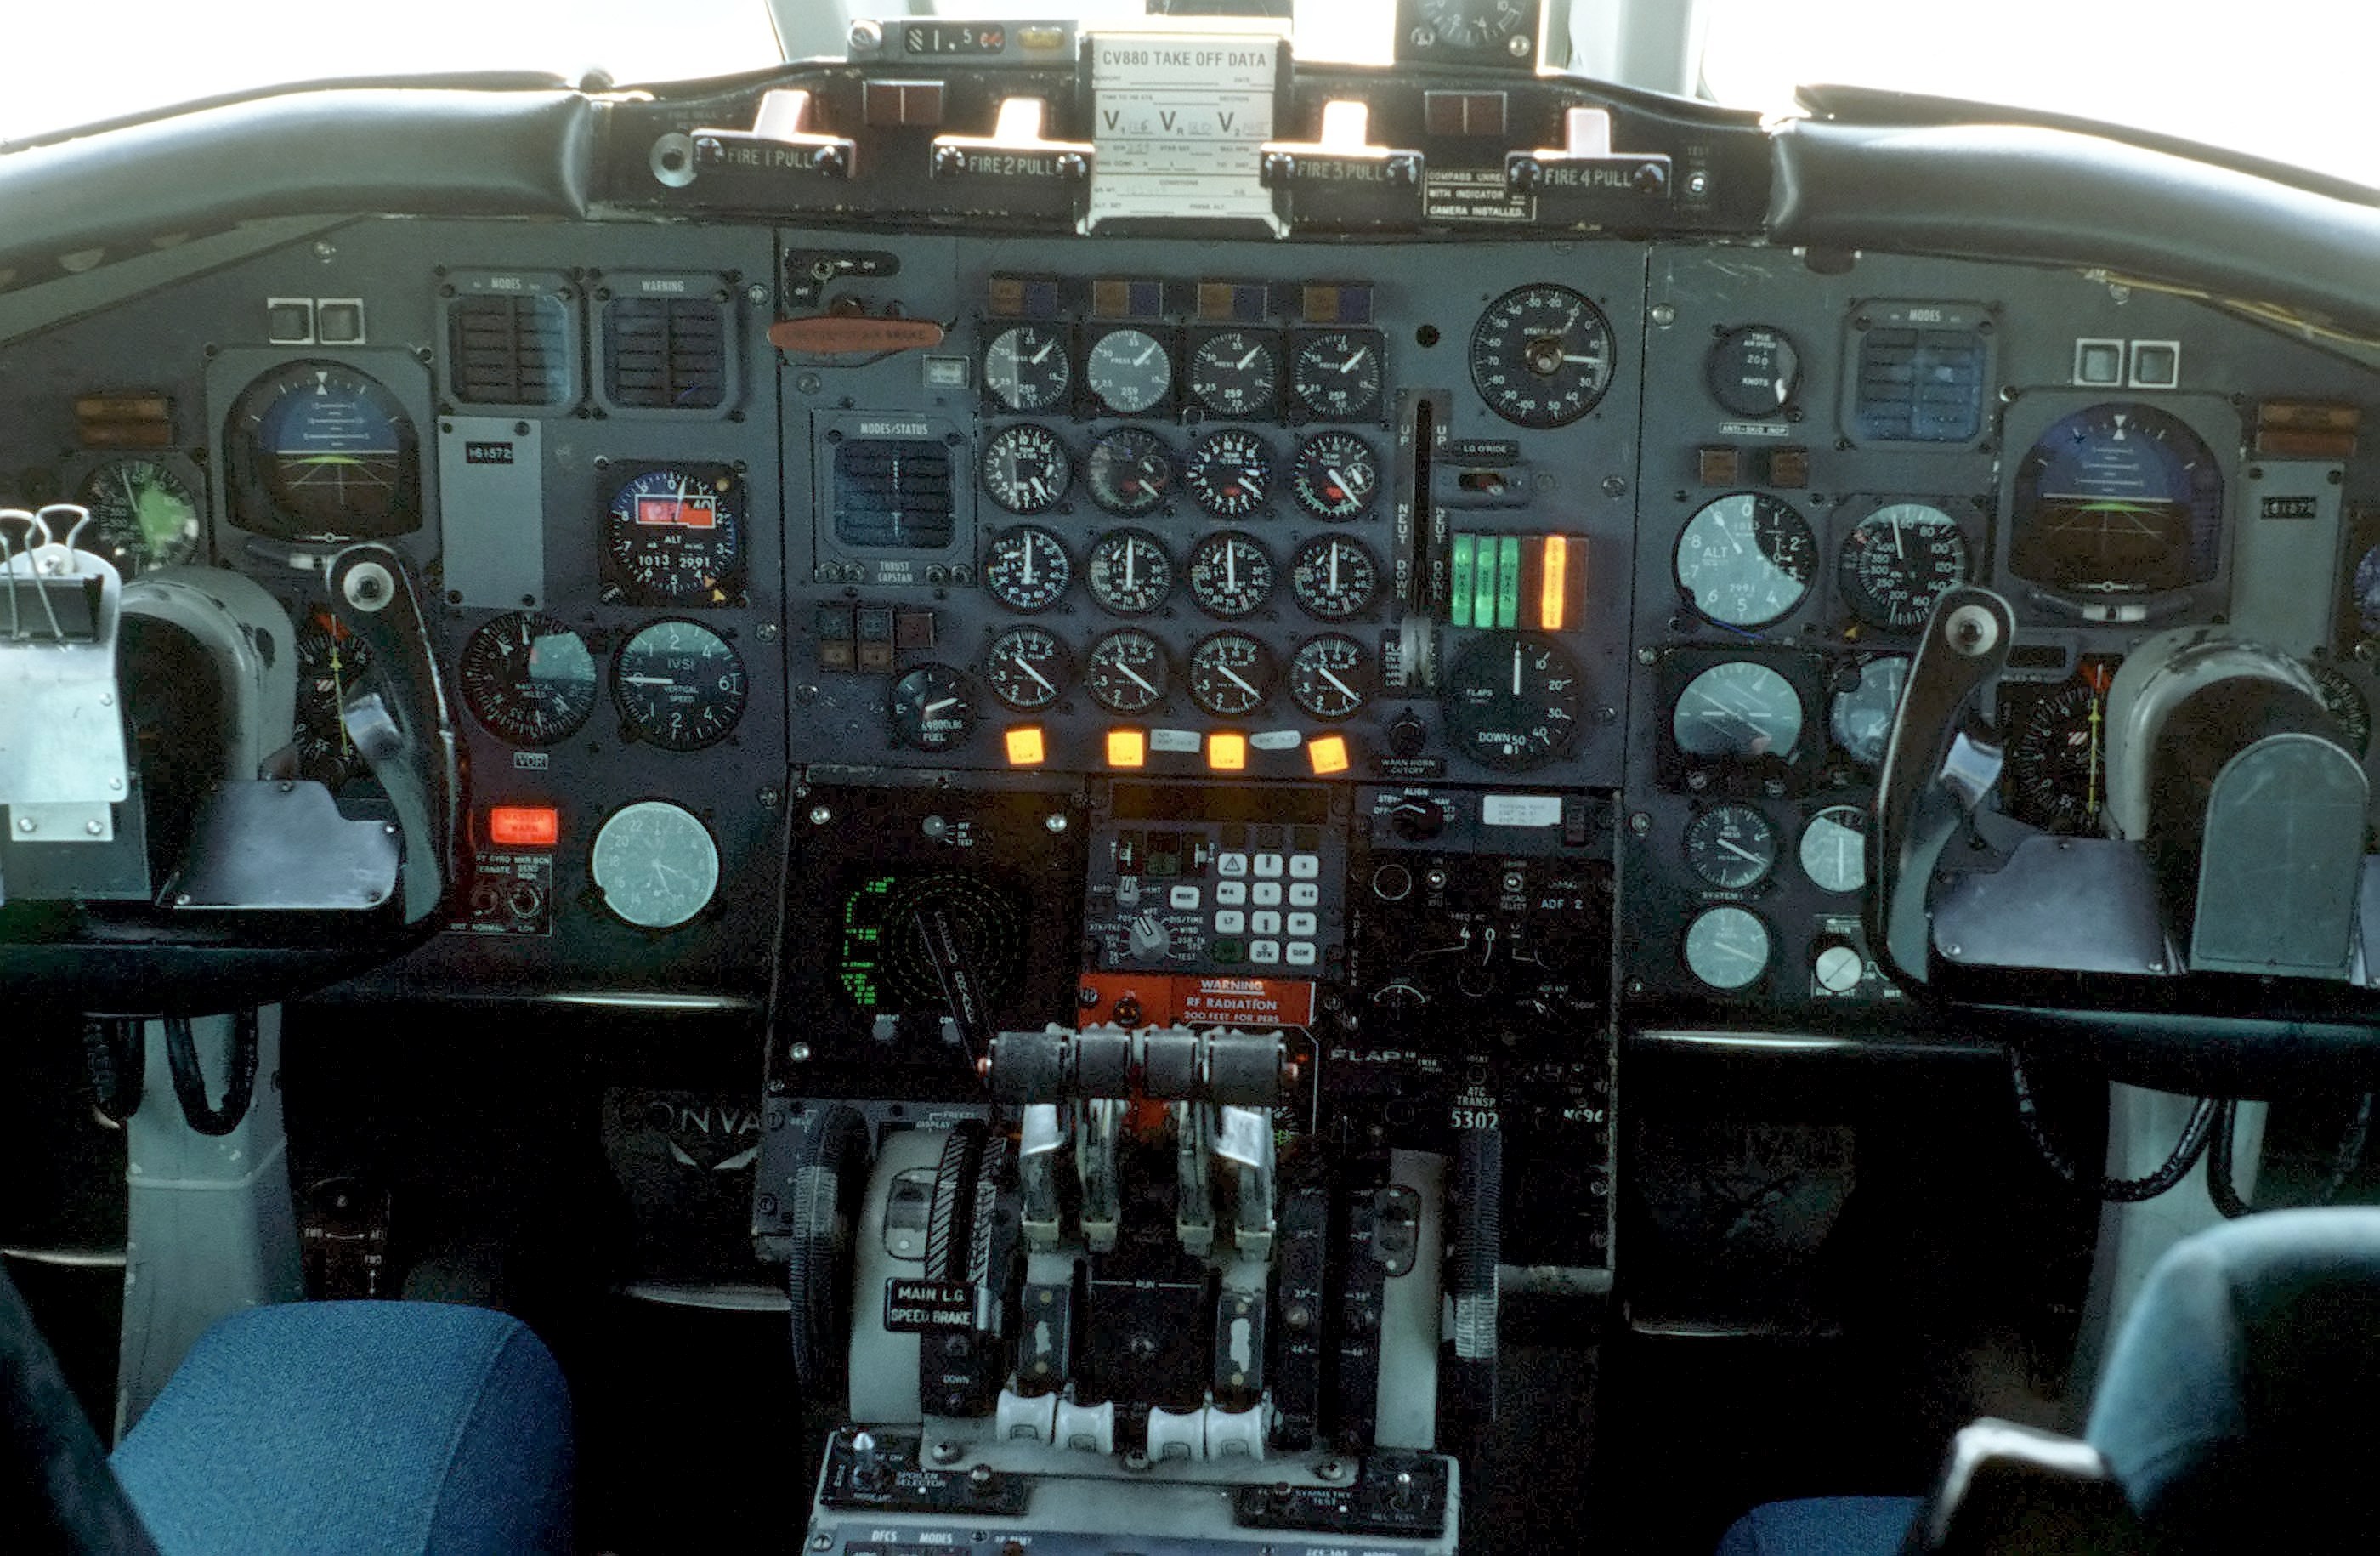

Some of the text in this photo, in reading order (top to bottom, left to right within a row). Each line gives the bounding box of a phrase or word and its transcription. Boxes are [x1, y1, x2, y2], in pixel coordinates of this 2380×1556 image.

[1103, 51, 1266, 66] CV880 TAKE OFF DATA
[728, 149, 759, 165] FIRE
[775, 150, 813, 168] PULL
[969, 156, 1055, 176] FIRE 2 PULL
[1297, 160, 1386, 181] FIRE 3 PULL
[1545, 169, 1633, 188] FIRE 4 PULL
[1456, 190, 1504, 201] INDICATOR
[1429, 205, 1469, 215] CAMERA
[491, 277, 523, 291] MODES
[642, 280, 685, 292] WARNING
[1910, 309, 1941, 322] MODES
[860, 423, 928, 435] MODES/STATUS
[668, 479, 676, 490] 0
[1742, 503, 1753, 516] 0
[664, 535, 681, 544] ALT
[1692, 535, 1701, 548] 8
[1790, 536, 1799, 551] 2
[1703, 546, 1727, 558] ALT
[880, 561, 910, 571] THRUST
[878, 573, 914, 582] CAPSTAN
[1789, 566, 1797, 581] 3
[1708, 589, 1718, 602] 6
[1737, 598, 1747, 612] 5
[671, 635, 680, 650] 2
[1466, 688, 1493, 696] FLAPS
[672, 713, 682, 728] 2
[1478, 731, 1510, 743] DOWN
[518, 756, 545, 767] VOR
[1540, 899, 1583, 910] ADF 2
[1201, 980, 1263, 991] WARNING
[1187, 997, 1277, 1010] RF RADIATION
[1209, 1012, 1229, 1020] FEET
[1457, 1096, 1496, 1107] TRANSP
[916, 1121, 951, 1129] DISPLAY
[1451, 1109, 1499, 1129] 5302
[898, 1286, 936, 1302] MAIN
[891, 1309, 971, 1326] SPEED BRAKE
[944, 1375, 969, 1385] DOWN
[871, 1531, 953, 1544] DFCS MODES
